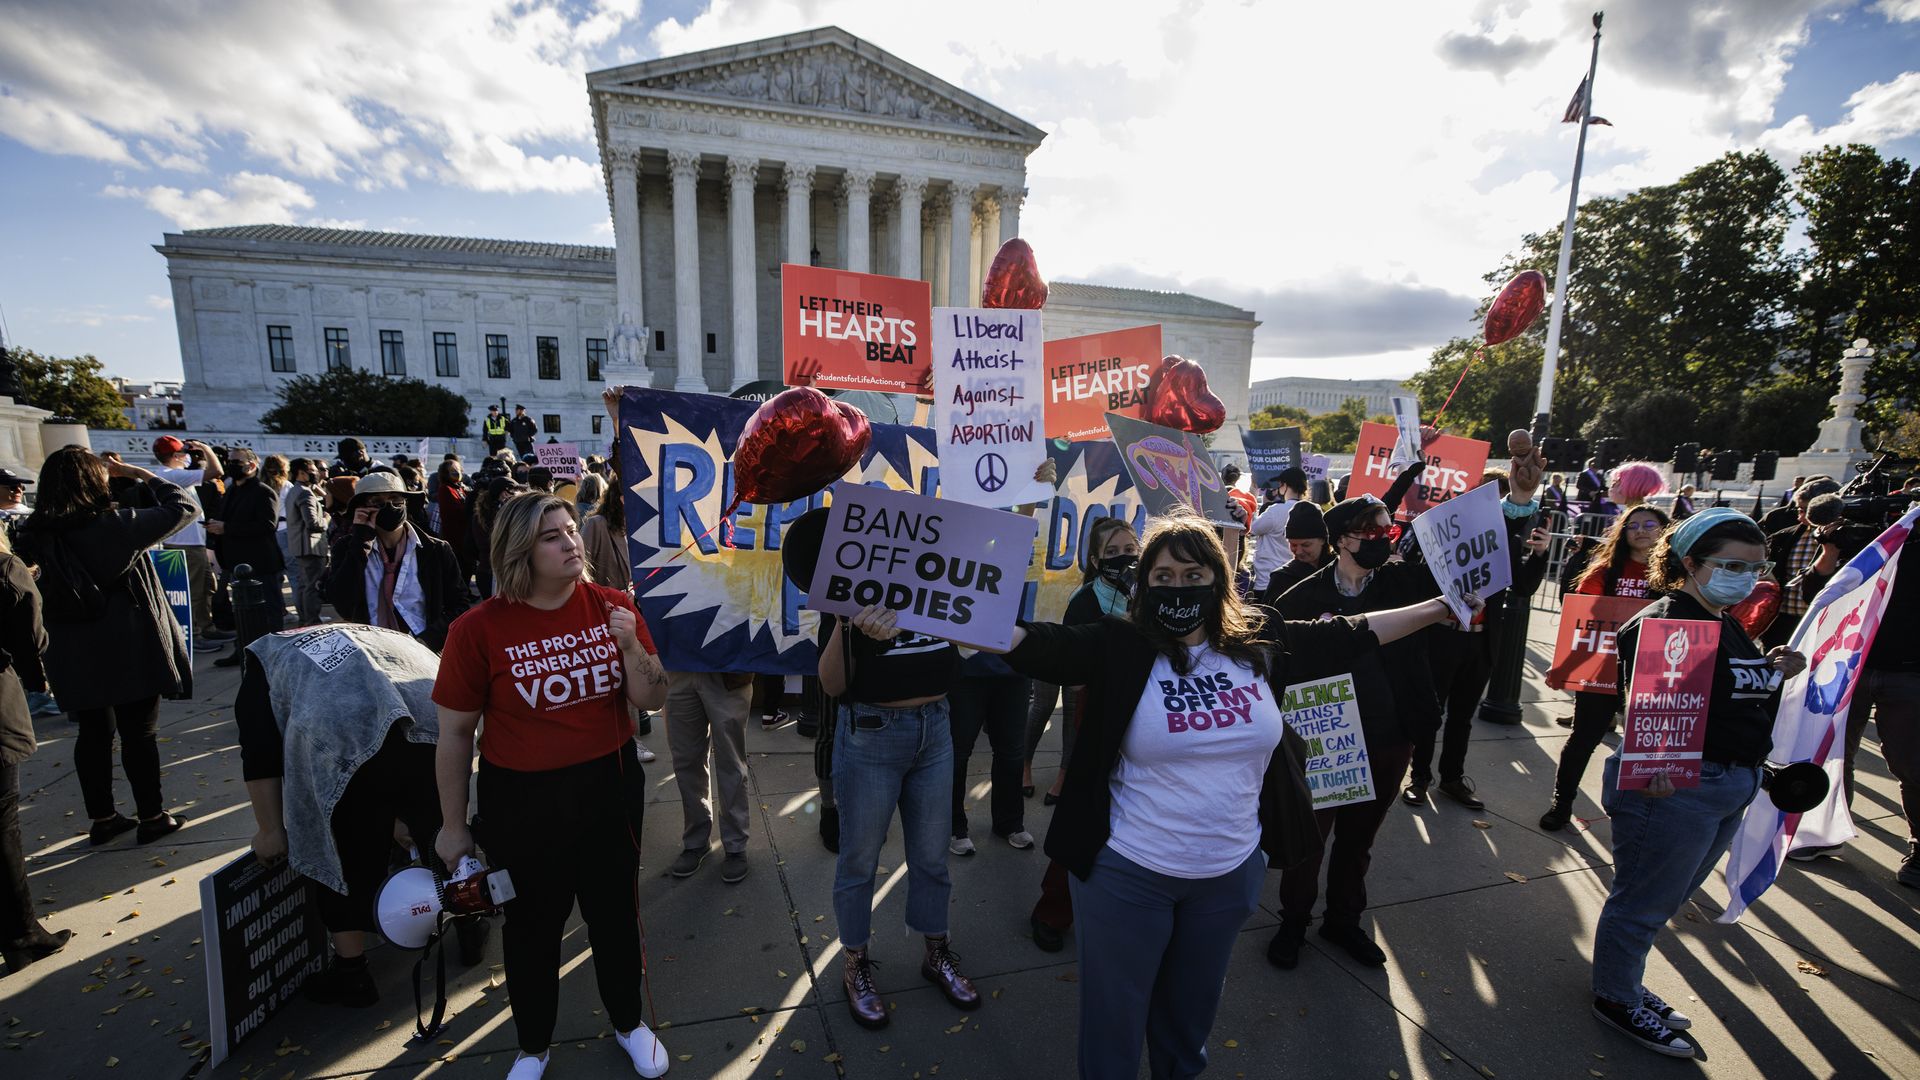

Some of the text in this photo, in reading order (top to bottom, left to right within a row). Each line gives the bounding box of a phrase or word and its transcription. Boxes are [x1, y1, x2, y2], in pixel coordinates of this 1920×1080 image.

[800, 295, 883, 318] LET THEIR
[800, 308, 917, 346] HEARTS
[866, 342, 917, 364] BEAT
[952, 348, 1024, 371] Atheist
[1051, 357, 1121, 380] LET THEIR
[816, 372, 906, 389] StudentsforLifeAction.org
[1051, 364, 1150, 404] HEARTS
[953, 382, 1024, 416] Against
[539, 448, 563, 457] BANS
[542, 457, 577, 465] OFF OUR
[550, 466, 575, 474] ODIES
[1303, 466, 1322, 475] OUR
[843, 503, 944, 545] BANS
[1422, 514, 1461, 556] BANS
[1455, 529, 1499, 567] OUR
[835, 541, 1002, 595] OFF OUR
[1617, 578, 1634, 588] THE
[825, 575, 975, 625] BODIES
[1158, 603, 1200, 619] MARCH
[1576, 619, 1606, 631] LET
[321, 656, 340, 668] FOR
[325, 647, 357, 671] HUMANS
[505, 641, 540, 660] THE
[511, 641, 617, 678] GENERATION
[514, 660, 623, 709] VOTES
[1158, 672, 1233, 696] BANS
[1280, 679, 1354, 712] OLENCE
[1164, 683, 1263, 712] OFF MY
[1634, 693, 1704, 710] FEMINISM:
[1167, 703, 1253, 733] BODY
[1283, 703, 1345, 724] GAINST
[1634, 717, 1697, 731] EQUALITY
[1295, 717, 1350, 737] OTHER
[1326, 733, 1355, 750] CAN
[1636, 733, 1661, 747] FOR
[1337, 752, 1354, 766] BE
[264, 866, 300, 899] mplex
[225, 889, 260, 930] NOW!
[244, 886, 307, 947] Industrial
[250, 915, 304, 970] Abortion
[249, 939, 309, 1000] Down The
[235, 1004, 266, 1043] Shut
